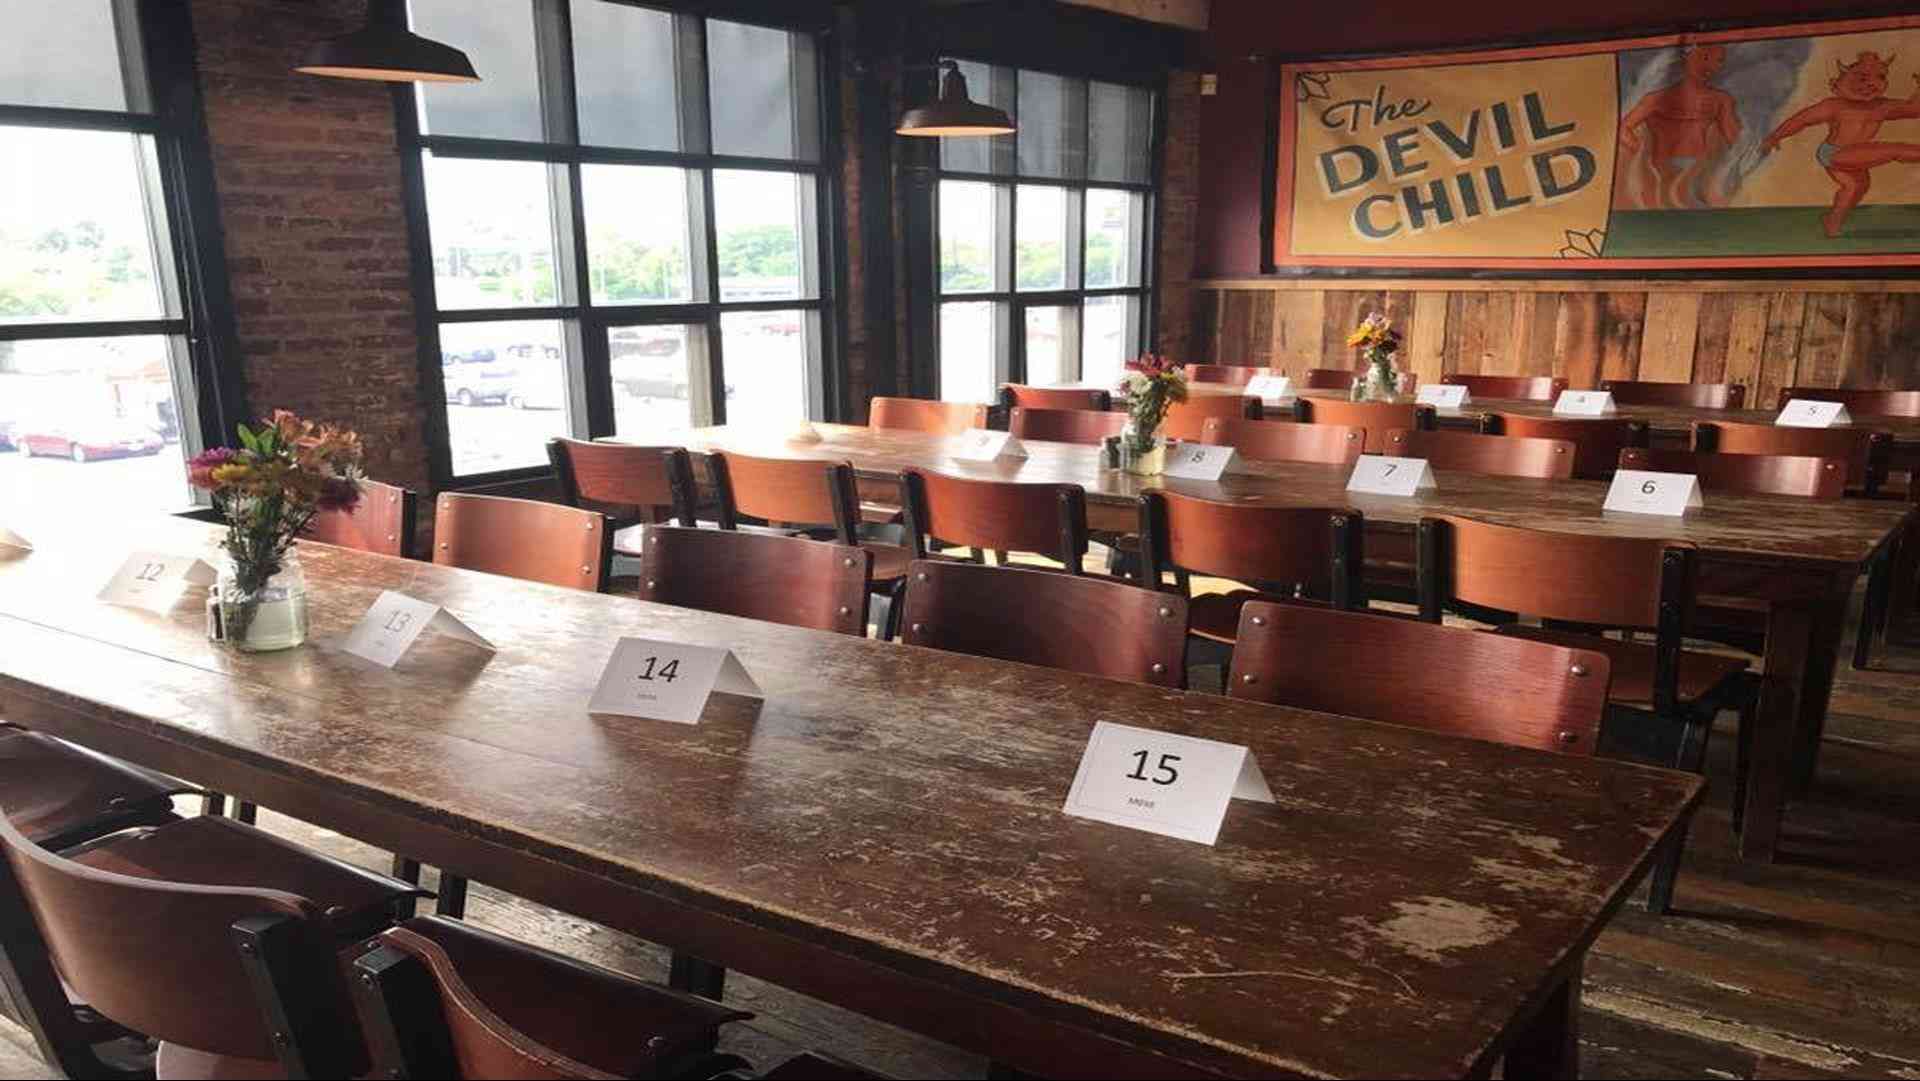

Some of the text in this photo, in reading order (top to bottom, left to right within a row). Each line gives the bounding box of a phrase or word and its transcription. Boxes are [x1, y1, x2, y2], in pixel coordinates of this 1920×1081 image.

[1320, 84, 1432, 133] The
[1318, 91, 1576, 194] DEVIL
[1351, 145, 1598, 239] CHILD
[1191, 450, 1206, 464] 8
[1383, 463, 1398, 478] 7
[1641, 479, 1656, 495] 6
[135, 562, 165, 582] 12
[637, 656, 681, 683] 14
[1125, 749, 1182, 786] 15
